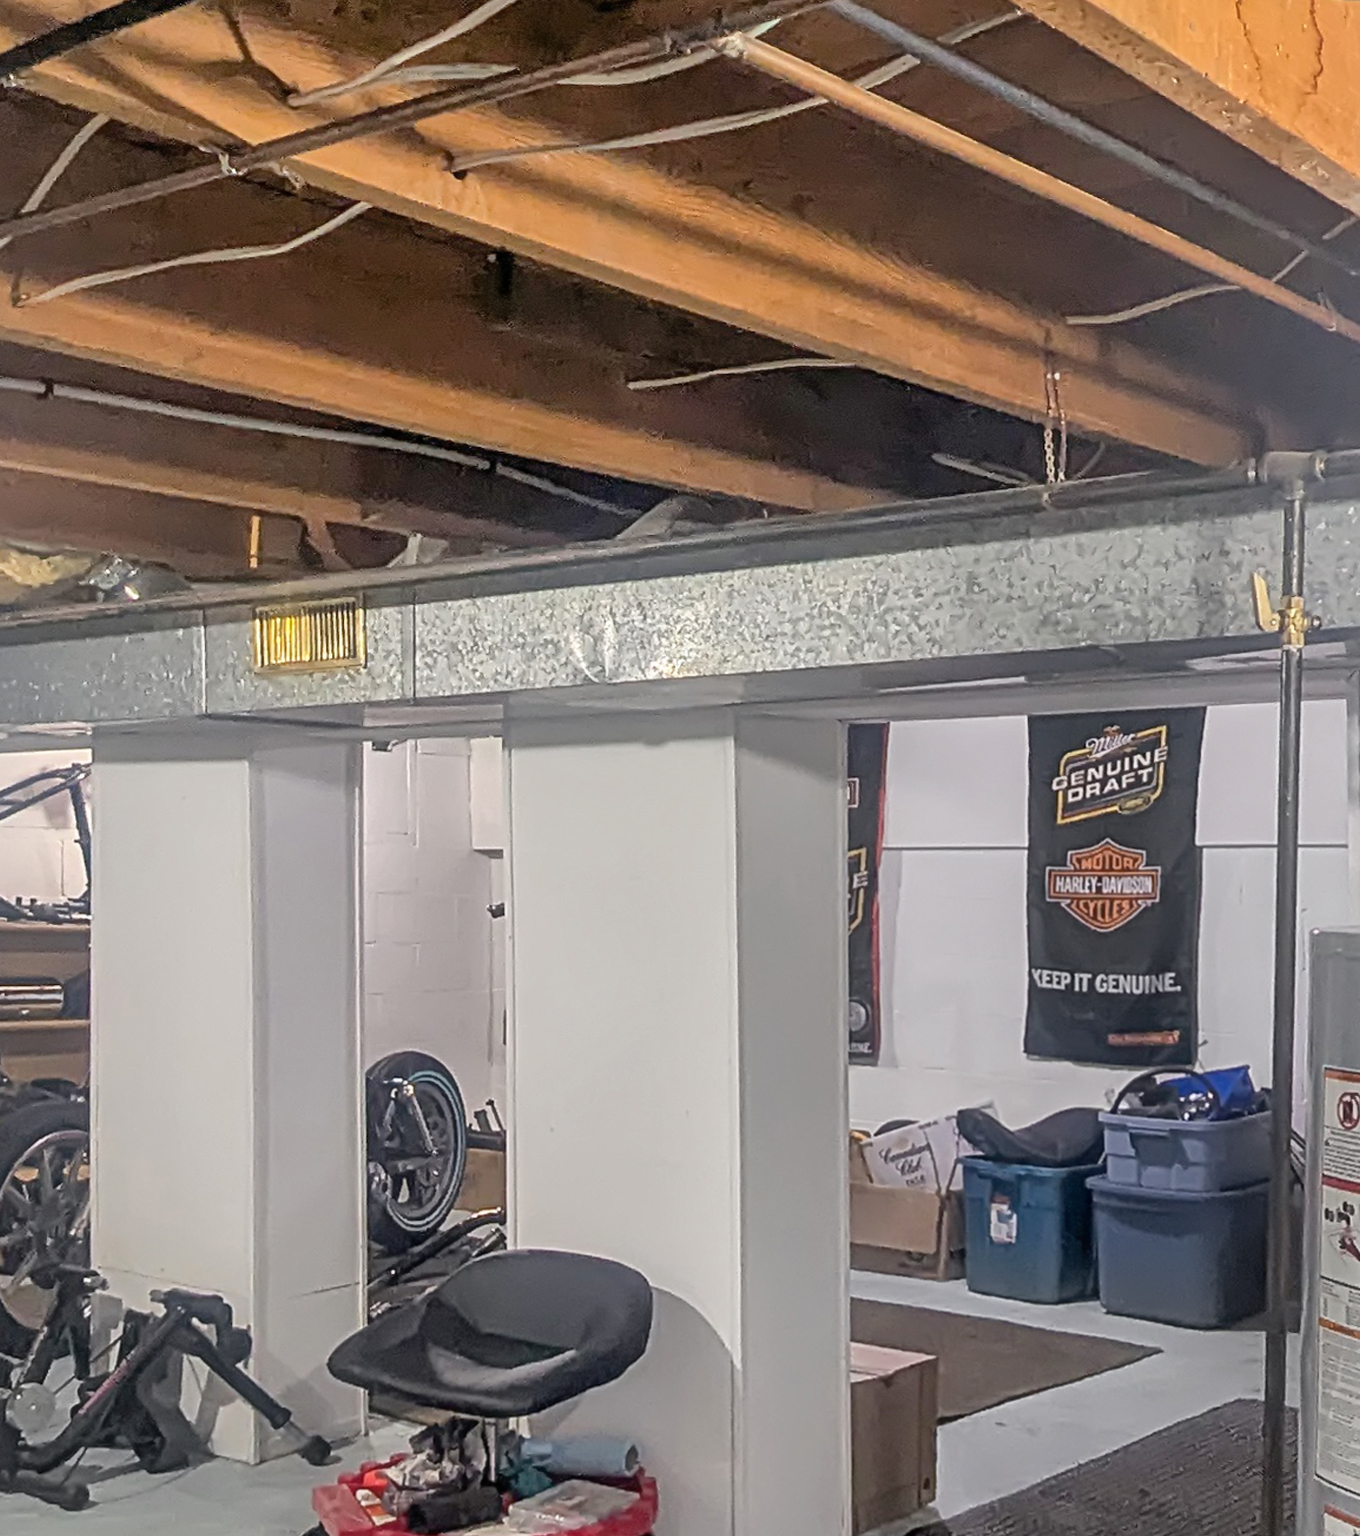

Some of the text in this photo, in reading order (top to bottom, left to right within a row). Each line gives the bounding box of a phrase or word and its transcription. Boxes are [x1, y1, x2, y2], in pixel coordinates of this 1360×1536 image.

[1085, 733, 1136, 758] Miller
[1051, 745, 1168, 791] GENUINE
[1067, 766, 1154, 803] DRAFT
[1081, 851, 1134, 870] MOTOR
[1055, 875, 1153, 893] HARLEY-DAVIDSON
[1080, 899, 1131, 923] CYCLES
[1031, 968, 1182, 995] KEEP IT GENUINE.
